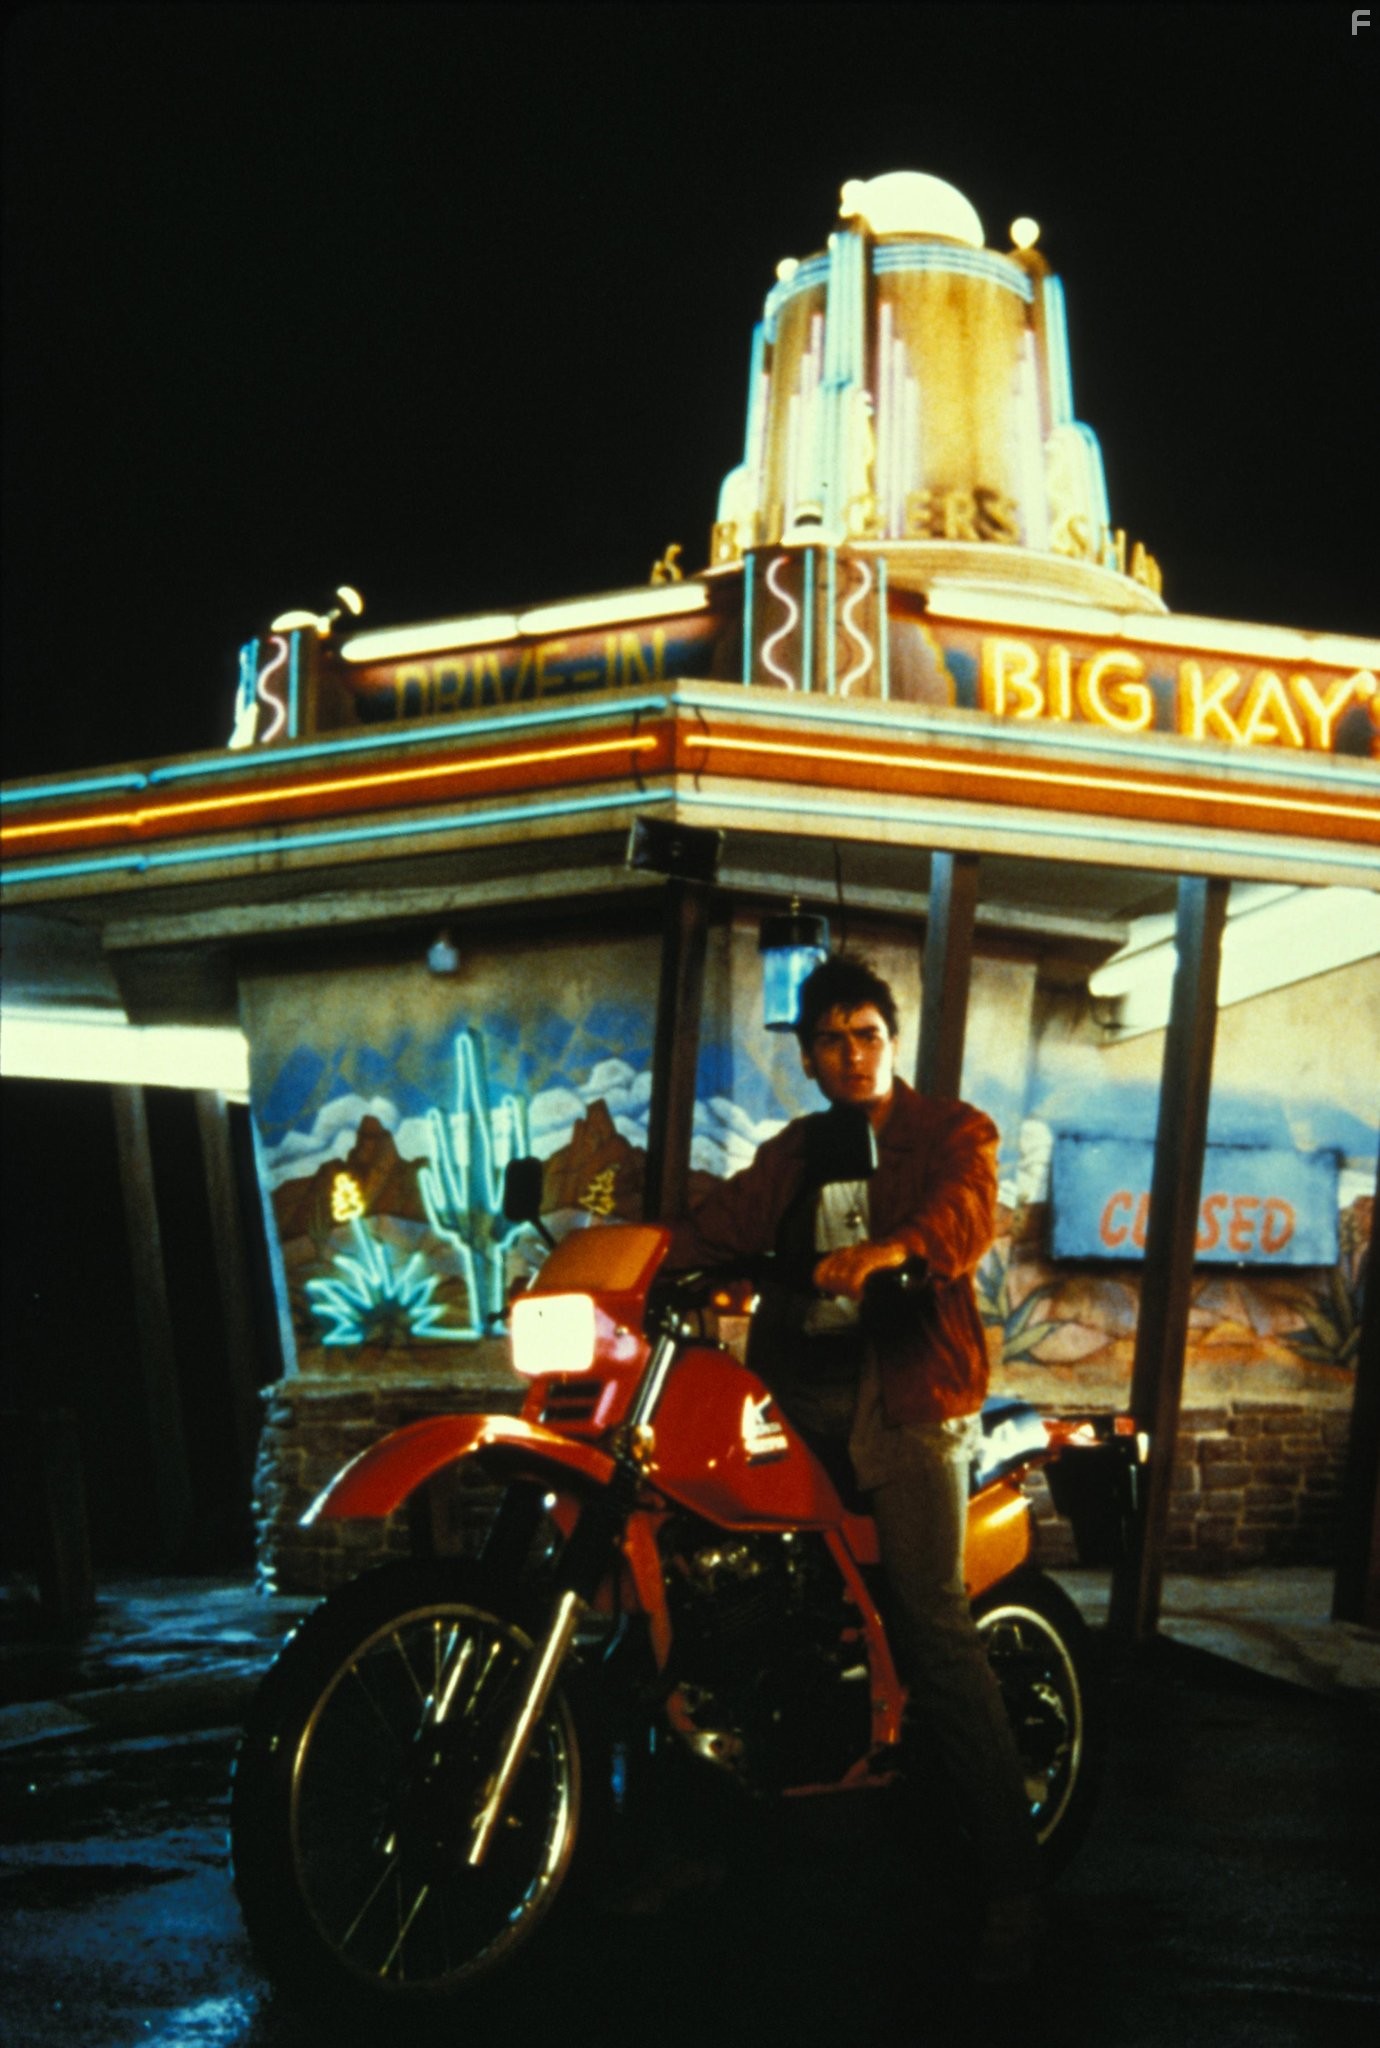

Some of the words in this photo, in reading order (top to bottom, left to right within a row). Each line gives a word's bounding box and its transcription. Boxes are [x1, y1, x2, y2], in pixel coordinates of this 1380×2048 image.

[711, 487, 1022, 568] BUGERS
[394, 626, 668, 719] DRIVE-IN
[981, 636, 1154, 732] BIG
[1179, 660, 1380, 748] KAY'
[1098, 1189, 1297, 1254] CLSED
